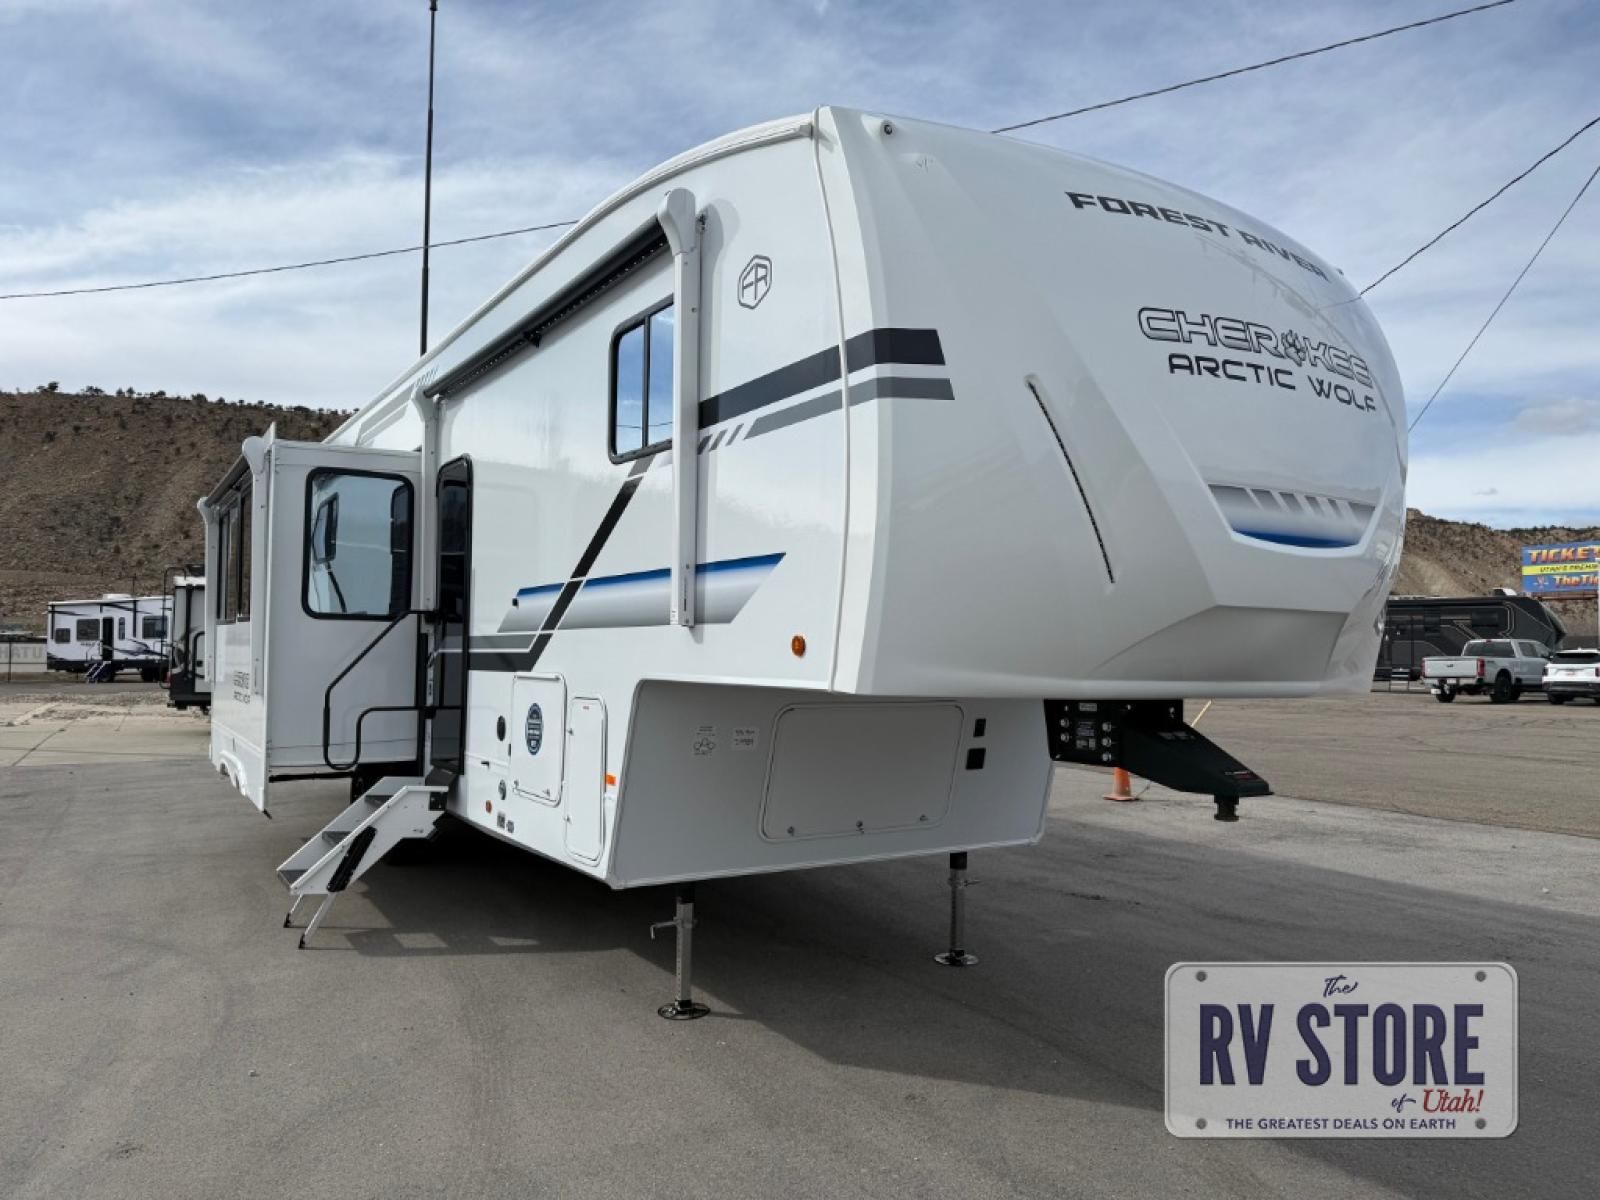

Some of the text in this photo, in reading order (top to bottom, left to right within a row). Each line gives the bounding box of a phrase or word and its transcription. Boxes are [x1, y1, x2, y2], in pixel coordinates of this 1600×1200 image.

[1064, 191, 1329, 282] FOREST RIVER
[1168, 353, 1377, 413] ARCTIC WOLF
